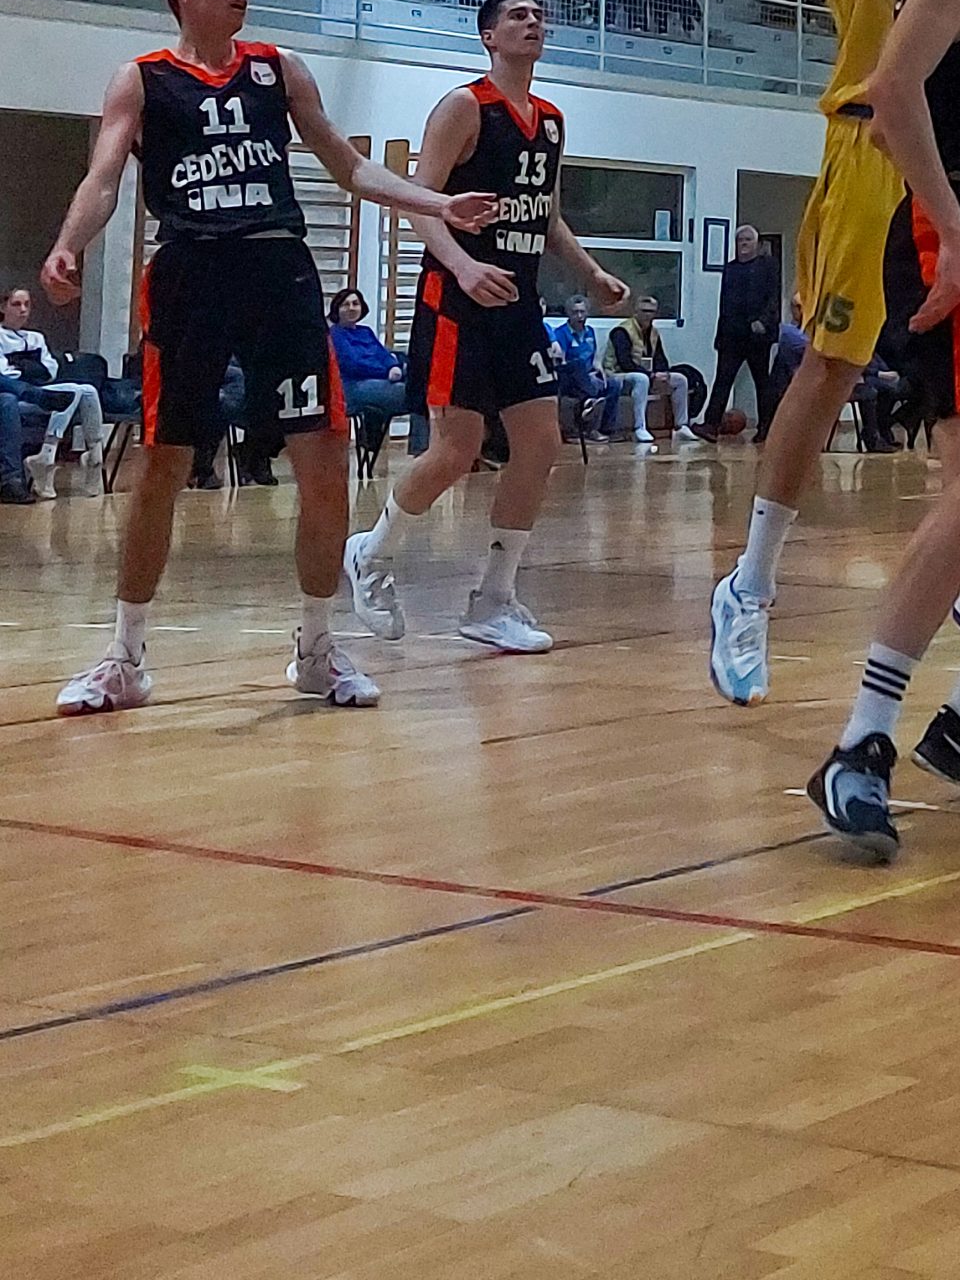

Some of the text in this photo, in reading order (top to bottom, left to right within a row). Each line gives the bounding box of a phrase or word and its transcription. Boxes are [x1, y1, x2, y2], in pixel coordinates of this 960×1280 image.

[199, 96, 250, 136] 11
[171, 139, 283, 189] CEDEVITA
[514, 150, 547, 187] 13
[276, 375, 325, 419] 11
